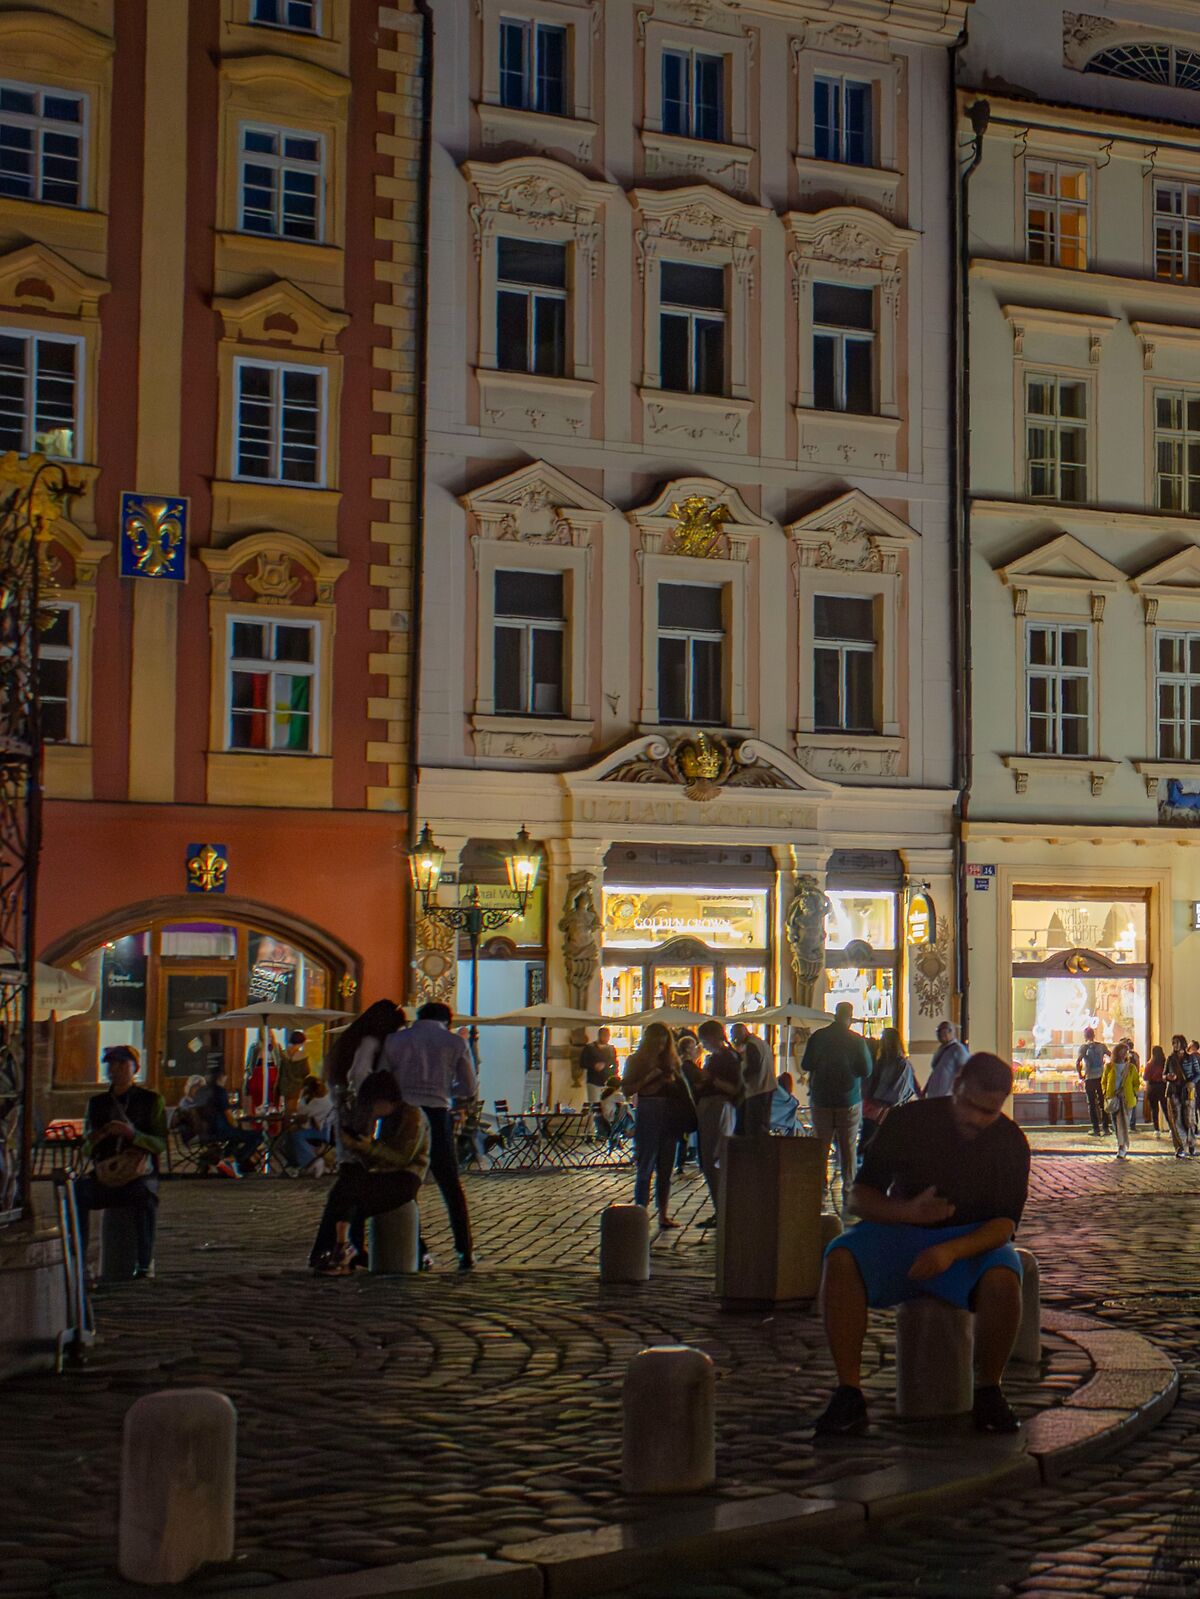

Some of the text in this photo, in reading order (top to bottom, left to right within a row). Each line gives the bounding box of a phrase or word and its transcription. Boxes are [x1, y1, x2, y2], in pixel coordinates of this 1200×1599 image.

[633, 917, 731, 931] GOLDEN CROWN
[251, 977, 279, 992] CZECH
